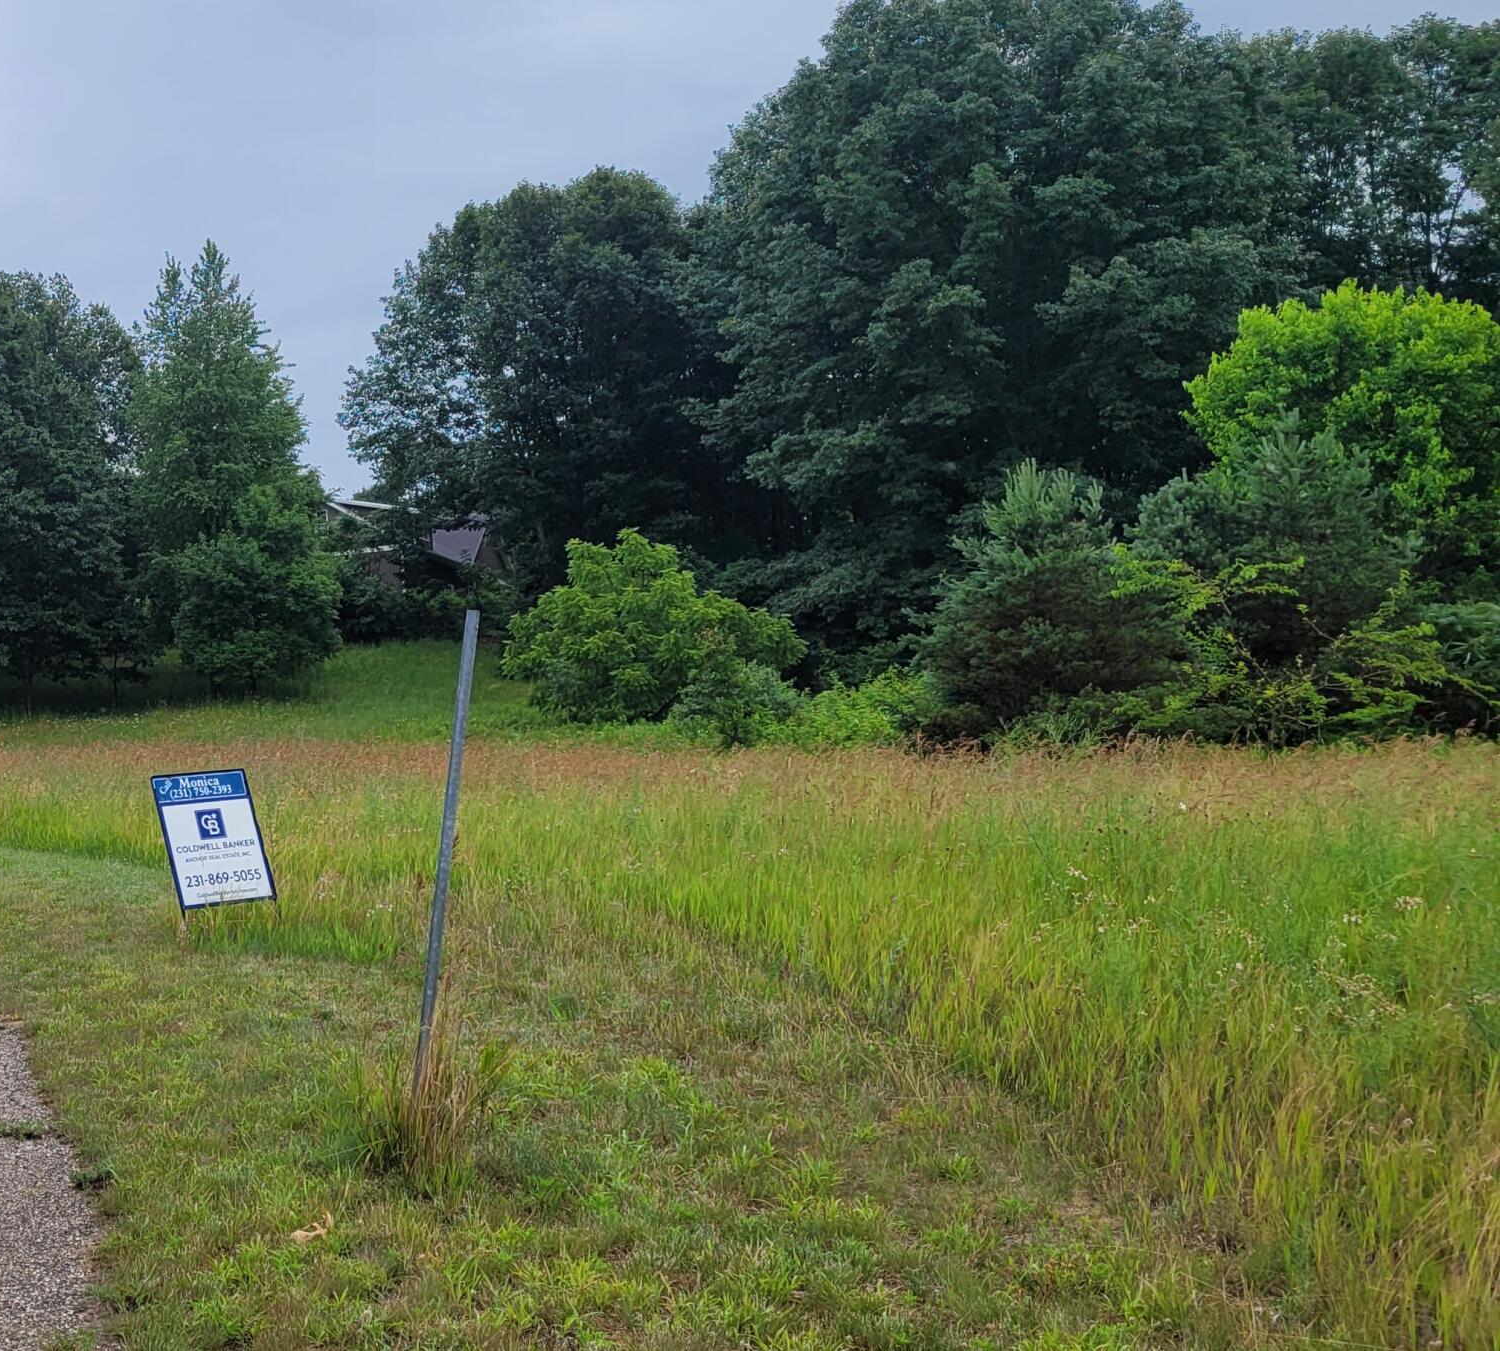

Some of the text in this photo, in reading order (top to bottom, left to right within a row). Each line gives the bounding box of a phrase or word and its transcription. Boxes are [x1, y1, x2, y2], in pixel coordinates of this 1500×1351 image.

[160, 780, 173, 795] Call
[179, 776, 220, 789] Monica
[169, 784, 232, 799] (231) 750-2393
[176, 839, 255, 854] COLDWELL BANKER
[185, 868, 262, 888] 231-869-5055
